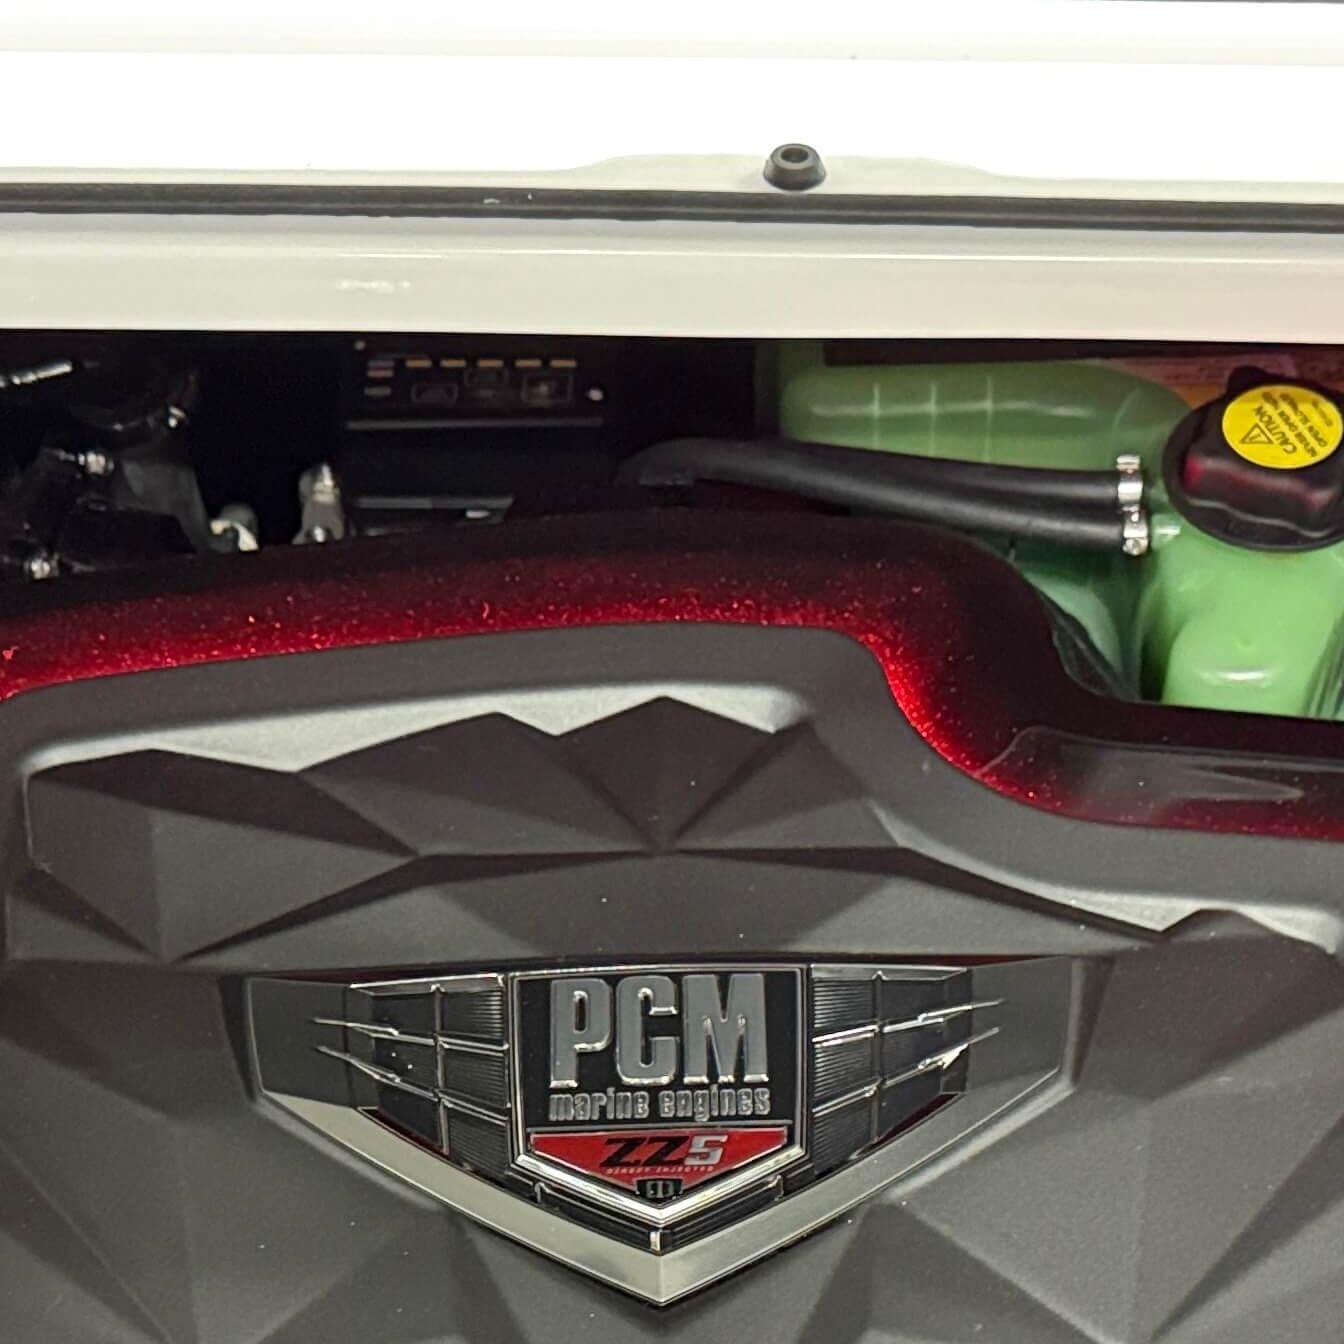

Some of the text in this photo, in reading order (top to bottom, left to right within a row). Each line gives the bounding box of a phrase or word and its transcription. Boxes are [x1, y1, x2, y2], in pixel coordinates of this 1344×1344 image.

[1254, 405, 1297, 454] CAUTION
[549, 973, 770, 1089] PCM
[548, 1083, 771, 1122] marine engines
[599, 1134, 729, 1168] ZZ5
